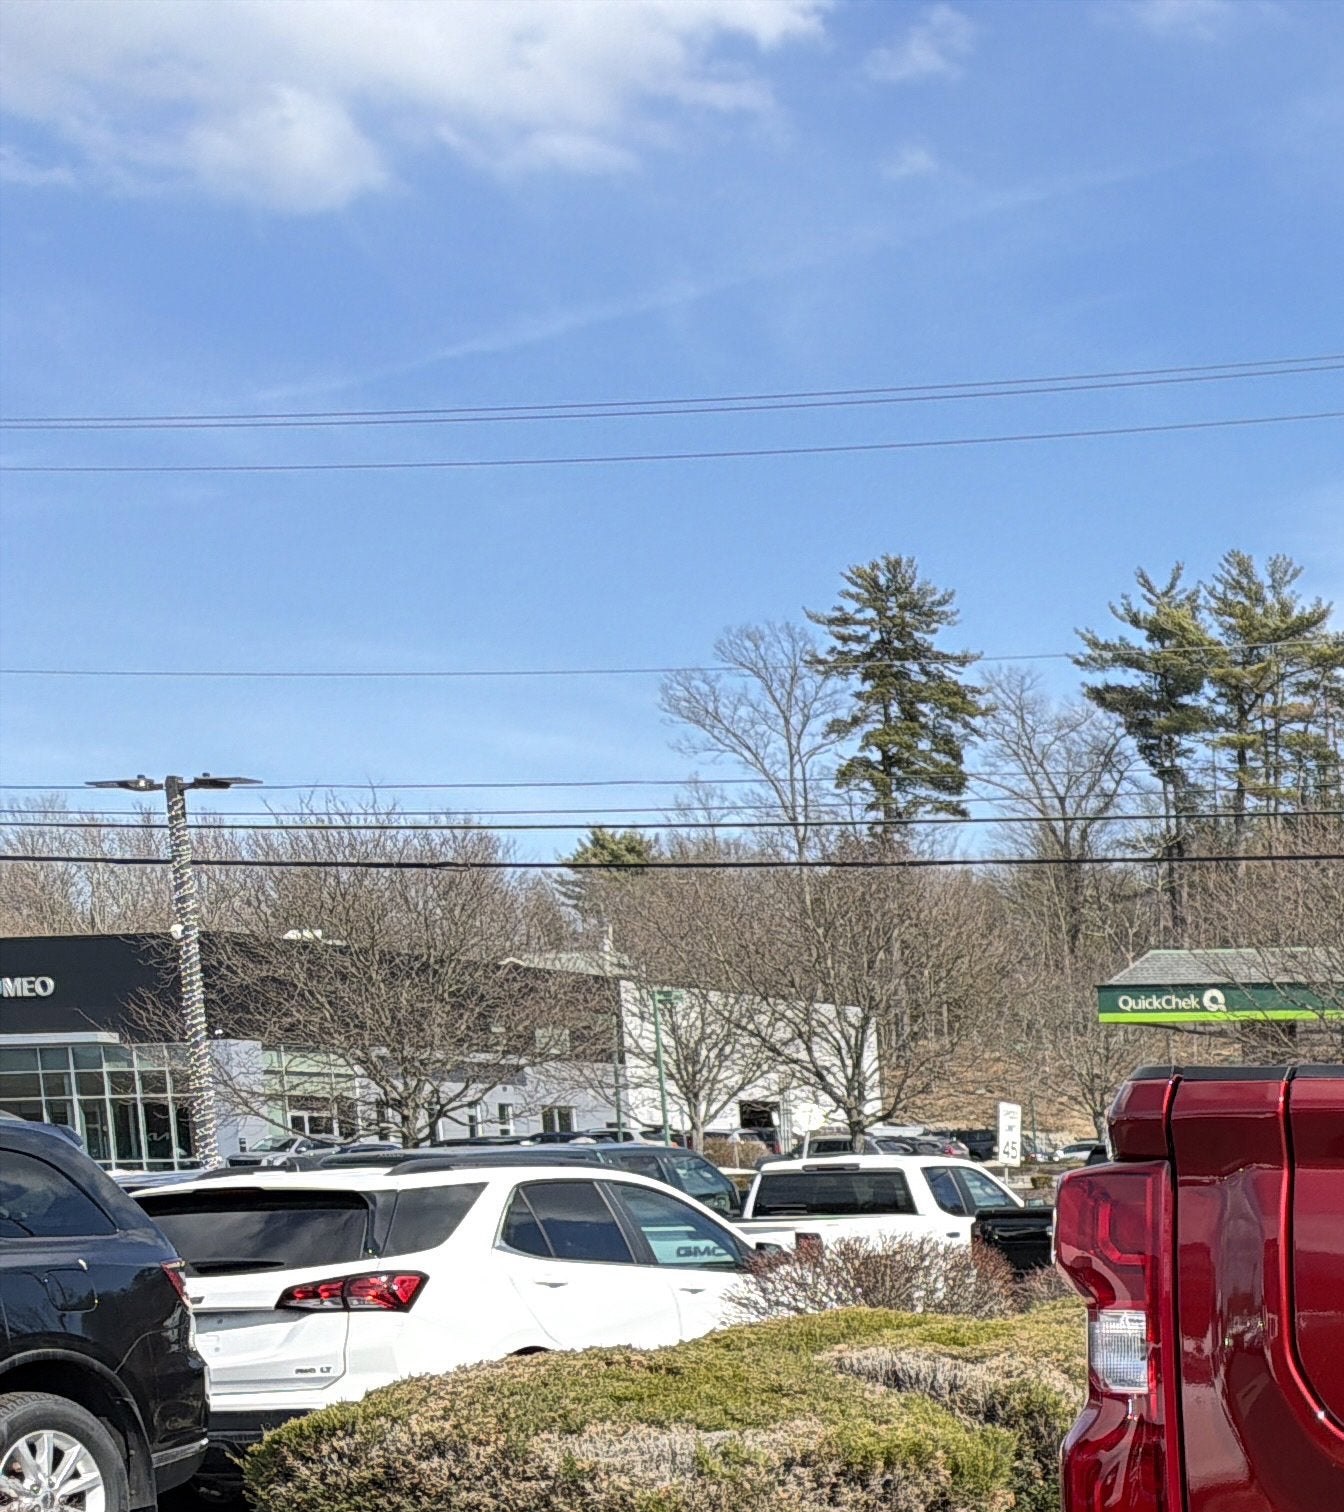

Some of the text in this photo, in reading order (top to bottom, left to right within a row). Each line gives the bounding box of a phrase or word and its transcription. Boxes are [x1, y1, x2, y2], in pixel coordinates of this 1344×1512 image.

[0, 976, 55, 998] MEO
[1118, 993, 1201, 1012] QuickChek
[1002, 1141, 1018, 1160] 45
[676, 1246, 730, 1258] GMC
